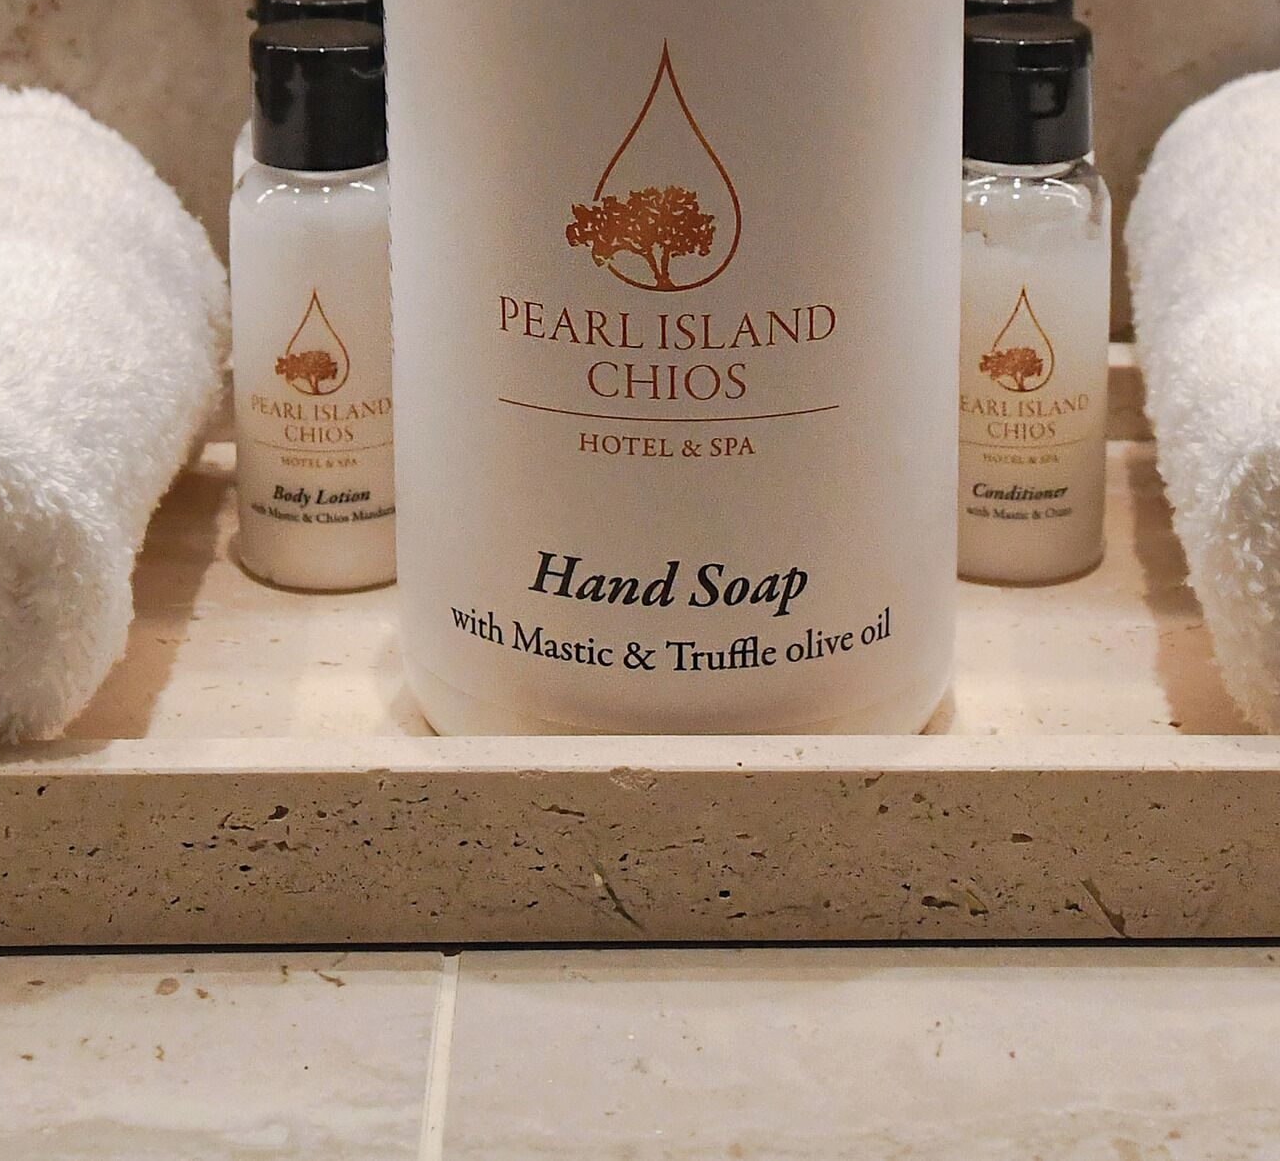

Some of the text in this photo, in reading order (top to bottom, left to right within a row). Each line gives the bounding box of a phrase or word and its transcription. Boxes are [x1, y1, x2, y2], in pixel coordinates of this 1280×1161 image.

[498, 295, 837, 350] PEARL ISLAND
[587, 361, 747, 401] CHIOS
[251, 394, 393, 420] PEARL ISLAND
[960, 394, 1089, 417] EARL ISLAND
[284, 424, 354, 443] CHIOS
[987, 422, 1056, 442] CHIOS
[578, 433, 757, 458] HOTEL & SPA
[273, 484, 312, 508] Body
[315, 489, 371, 506] Lotion
[972, 482, 1069, 501] Conditioner
[528, 550, 809, 617] Hand Soap
[451, 606, 892, 671] with Mastic & Truffle olive oil
